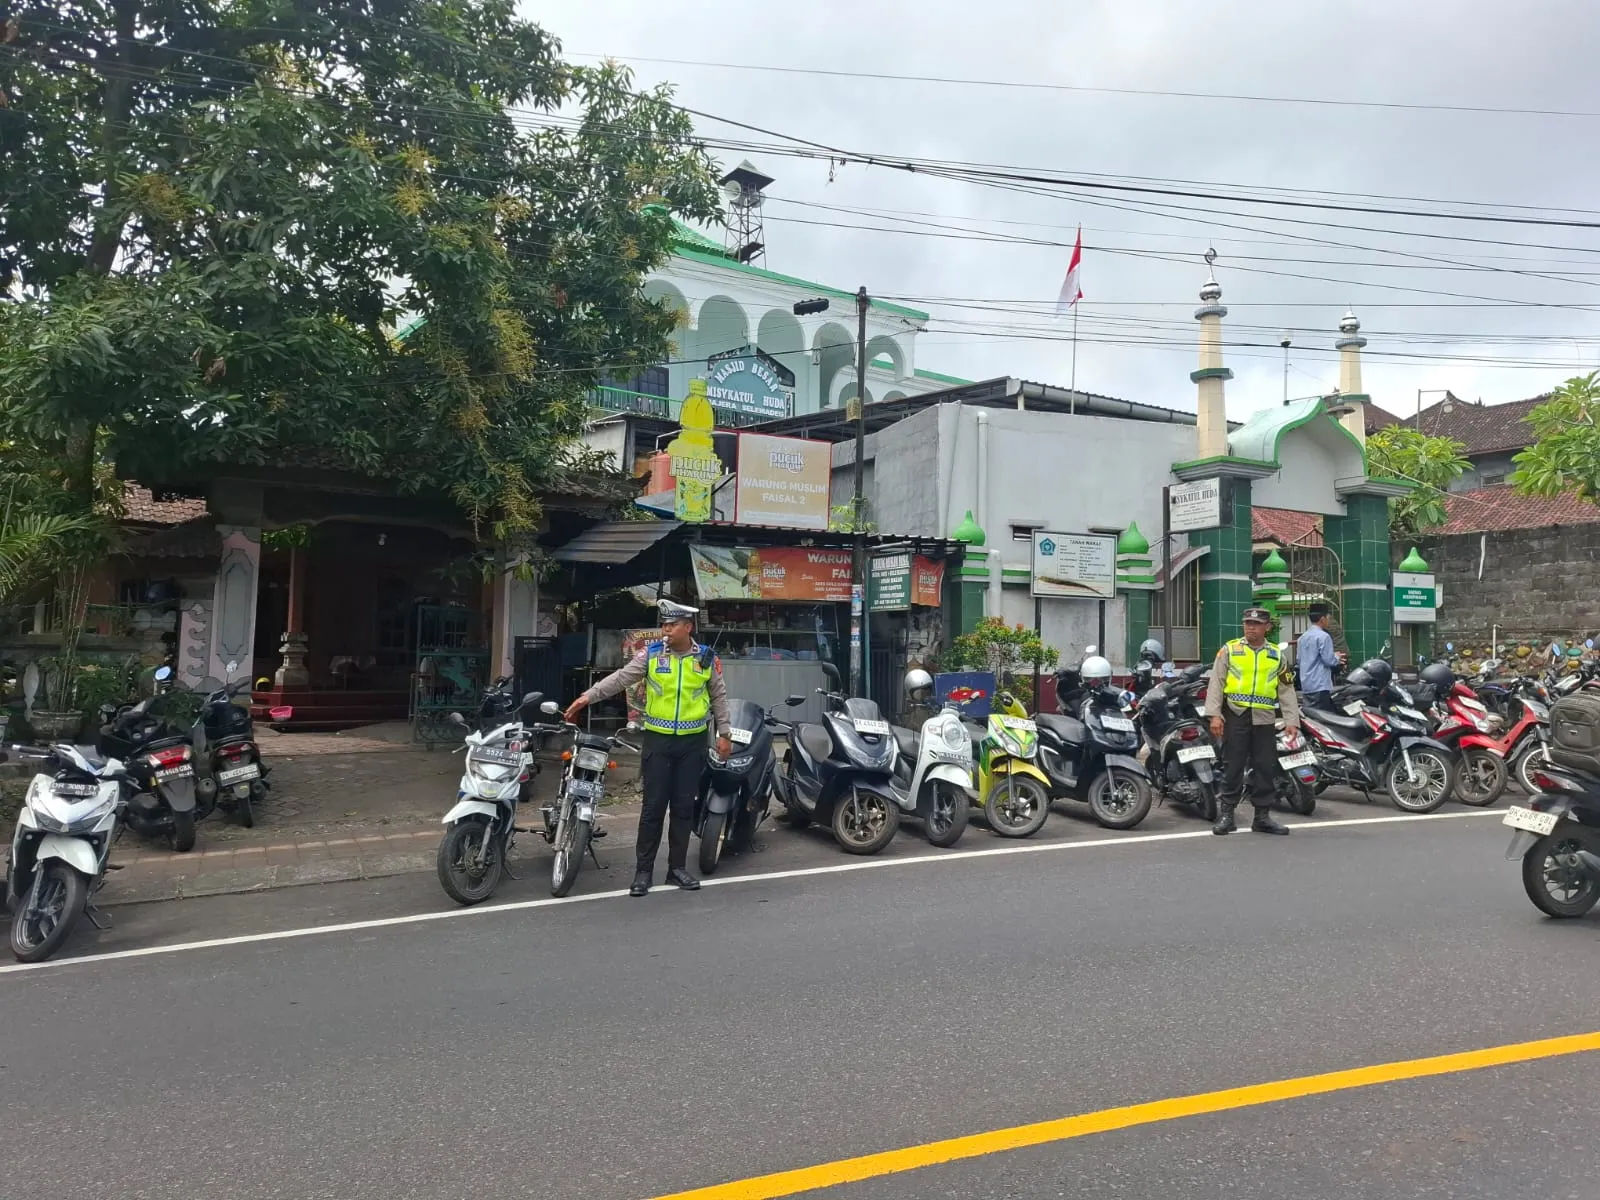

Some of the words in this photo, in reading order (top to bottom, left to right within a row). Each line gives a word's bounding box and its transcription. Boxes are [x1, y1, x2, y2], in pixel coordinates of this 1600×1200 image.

[714, 360, 745, 384] MASJID
[751, 363, 779, 393] BESAR
[706, 386, 755, 404] MISYKATUL
[762, 395, 785, 410] HUDA
[671, 455, 721, 477] pucuk
[769, 452, 805, 470] pucuk
[742, 477, 787, 491] WARUNG
[789, 481, 826, 494] MUSLIM
[762, 492, 797, 503] FAISAL
[799, 495, 806, 505] 2
[807, 553, 852, 564] WARUN
[832, 568, 853, 579] FAI
